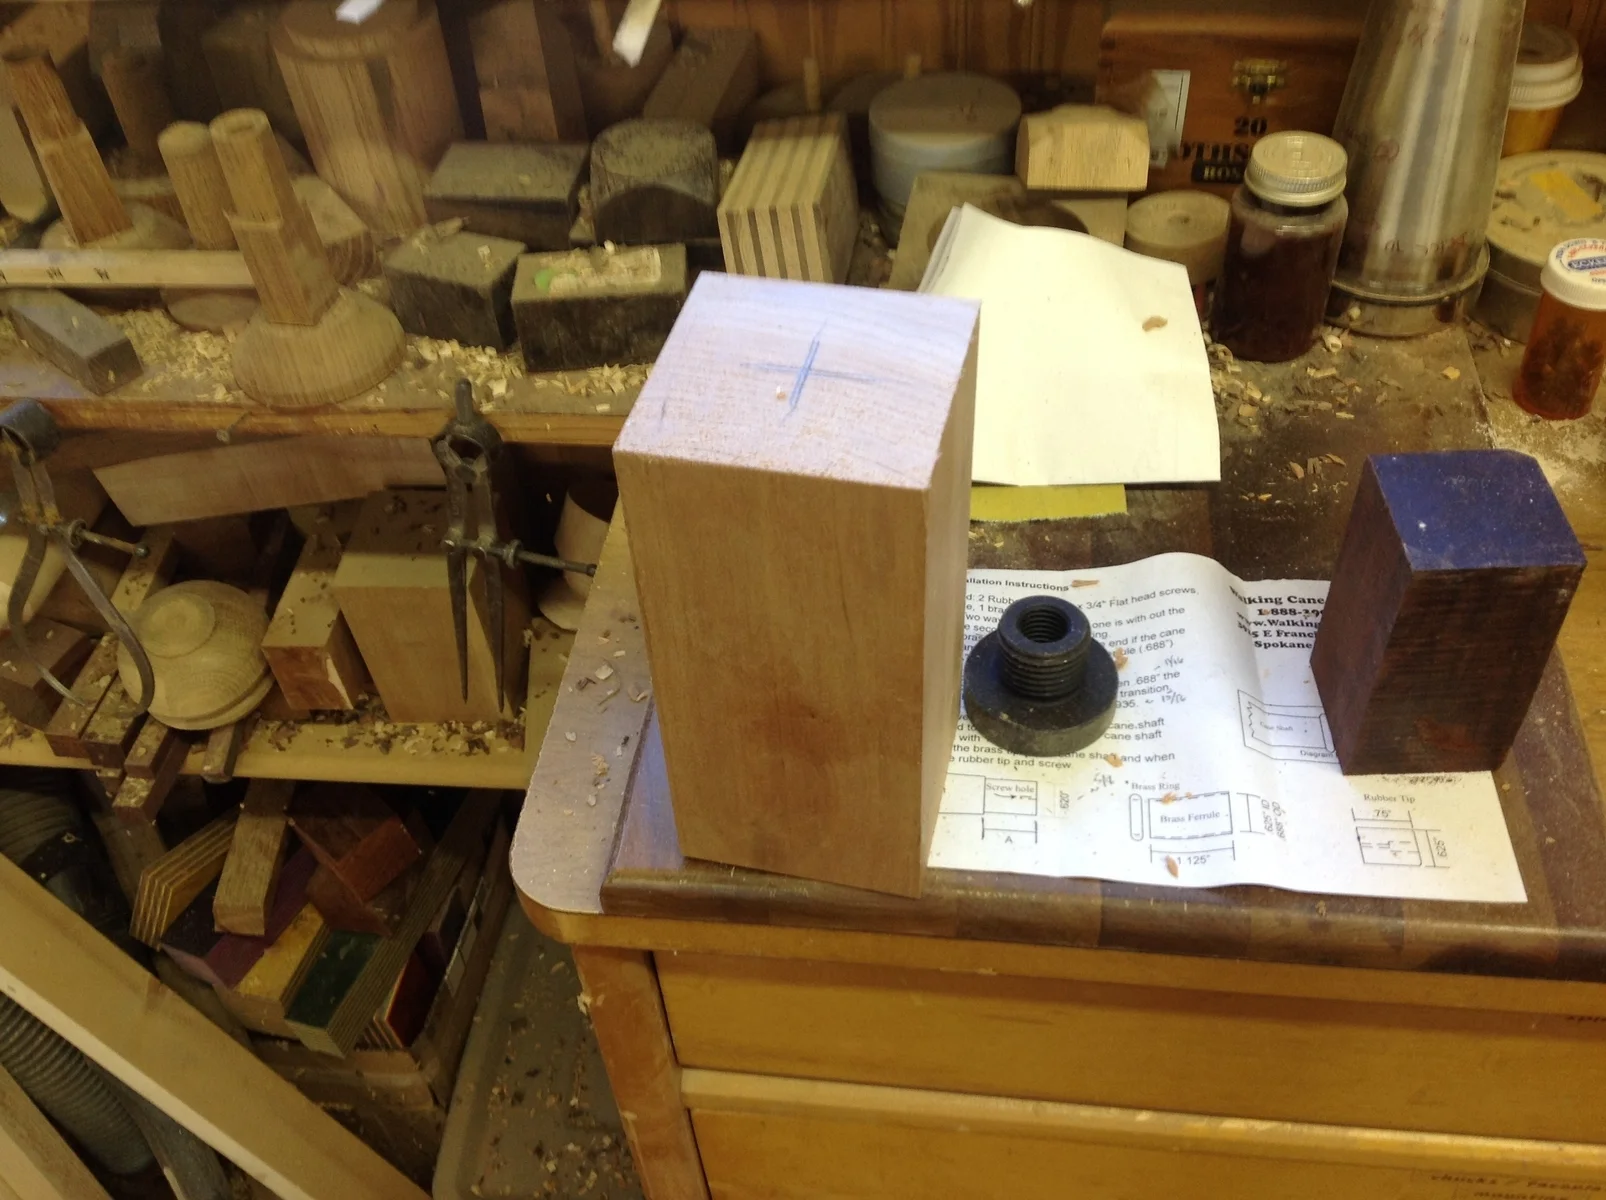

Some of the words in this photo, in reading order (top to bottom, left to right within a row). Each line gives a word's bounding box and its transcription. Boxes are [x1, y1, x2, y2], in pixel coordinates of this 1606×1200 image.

[1234, 116, 1267, 136] 20
[1005, 580, 1069, 592] Instructions
[978, 594, 985, 602] 2
[1109, 598, 1129, 608] Flat
[1131, 592, 1156, 603] head
[1092, 620, 1112, 628] one
[1115, 618, 1123, 626] is
[1126, 614, 1147, 625] with
[1149, 610, 1165, 620] out
[1168, 607, 1186, 615] the
[1109, 638, 1128, 648] end
[1131, 635, 1138, 644] if
[1140, 633, 1157, 642] the
[1160, 627, 1186, 638] cane
[1263, 629, 1272, 638] E
[1254, 640, 1313, 650] Spokane
[1163, 671, 1181, 681] the
[1137, 717, 1165, 729] shaft
[959, 734, 981, 742] with
[1104, 732, 1131, 740] cane
[1135, 729, 1162, 740] shaft
[953, 744, 970, 752] the
[973, 745, 1003, 754] brass
[1121, 754, 1141, 763] and
[1144, 752, 1175, 763] when
[1300, 749, 1334, 759] Diagram
[958, 755, 994, 764] rubber
[997, 757, 1010, 766] tip
[1014, 758, 1035, 767] and
[1039, 761, 1072, 769] screw
[986, 782, 1013, 792] Screw
[1015, 784, 1035, 793] hole
[1131, 782, 1156, 791] Brass
[1158, 781, 1181, 791] Ring
[1363, 793, 1397, 802] Rubber
[1401, 794, 1416, 804] Tip
[1160, 815, 1185, 824] Brass
[1188, 810, 1221, 822] Ferrule
[1004, 835, 1013, 844] A
